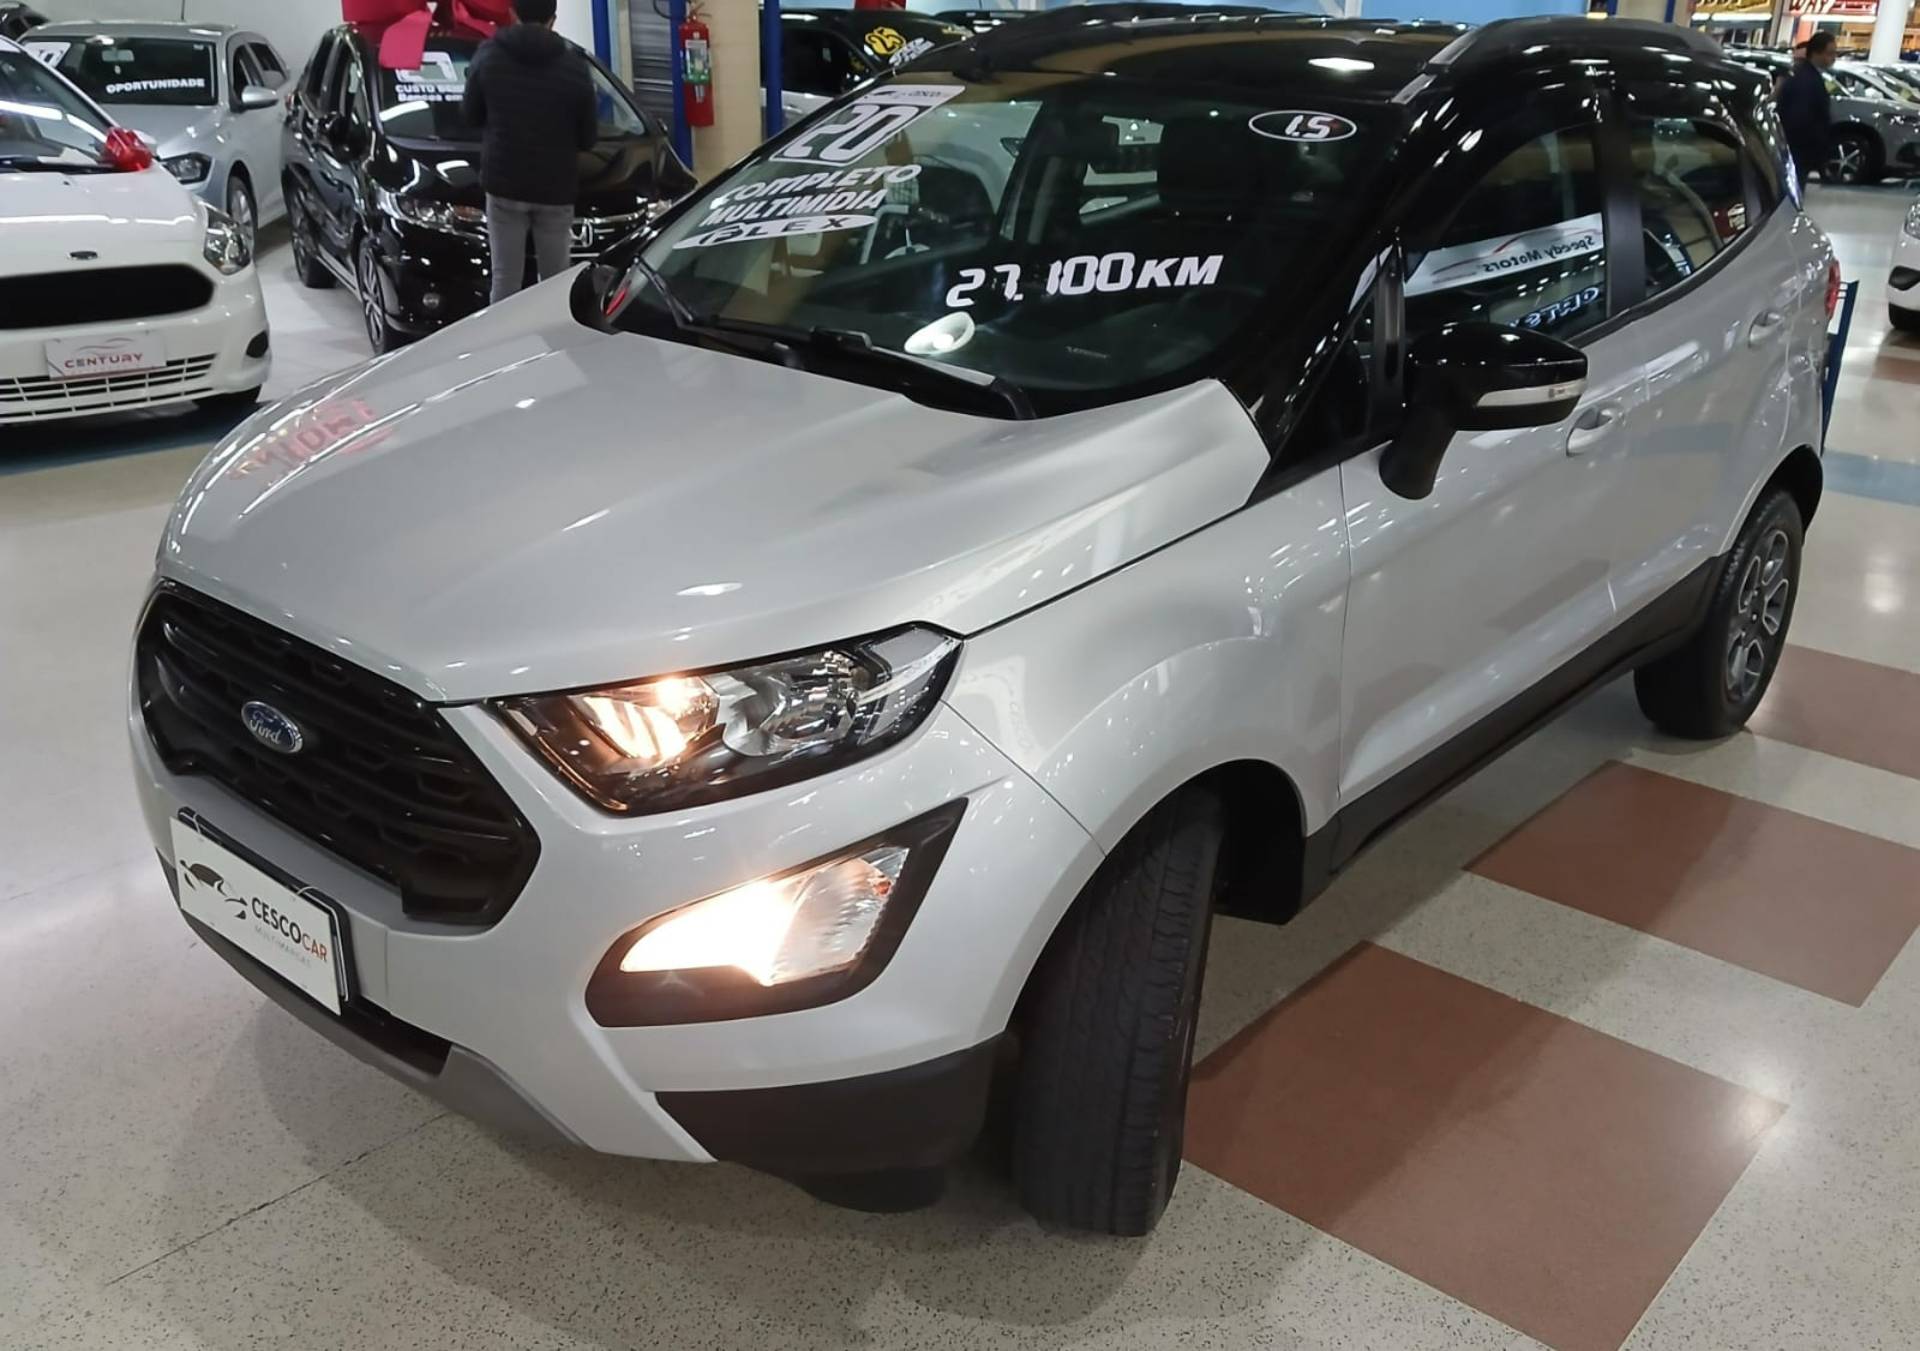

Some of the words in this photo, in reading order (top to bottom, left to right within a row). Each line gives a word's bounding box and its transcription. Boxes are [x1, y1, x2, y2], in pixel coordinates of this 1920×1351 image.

[106, 78, 205, 94] OPORTUNIDADE
[395, 83, 436, 93] CUSTO
[783, 104, 919, 162] 20
[1284, 115, 1336, 139] 1.5
[712, 165, 922, 207] COMPLETO
[699, 187, 888, 227] MULTIMÍDIA
[701, 217, 849, 245] FLEX
[64, 353, 143, 369] CENTURY
[250, 710, 281, 745] Ford
[252, 897, 327, 962] CESCOCAR
